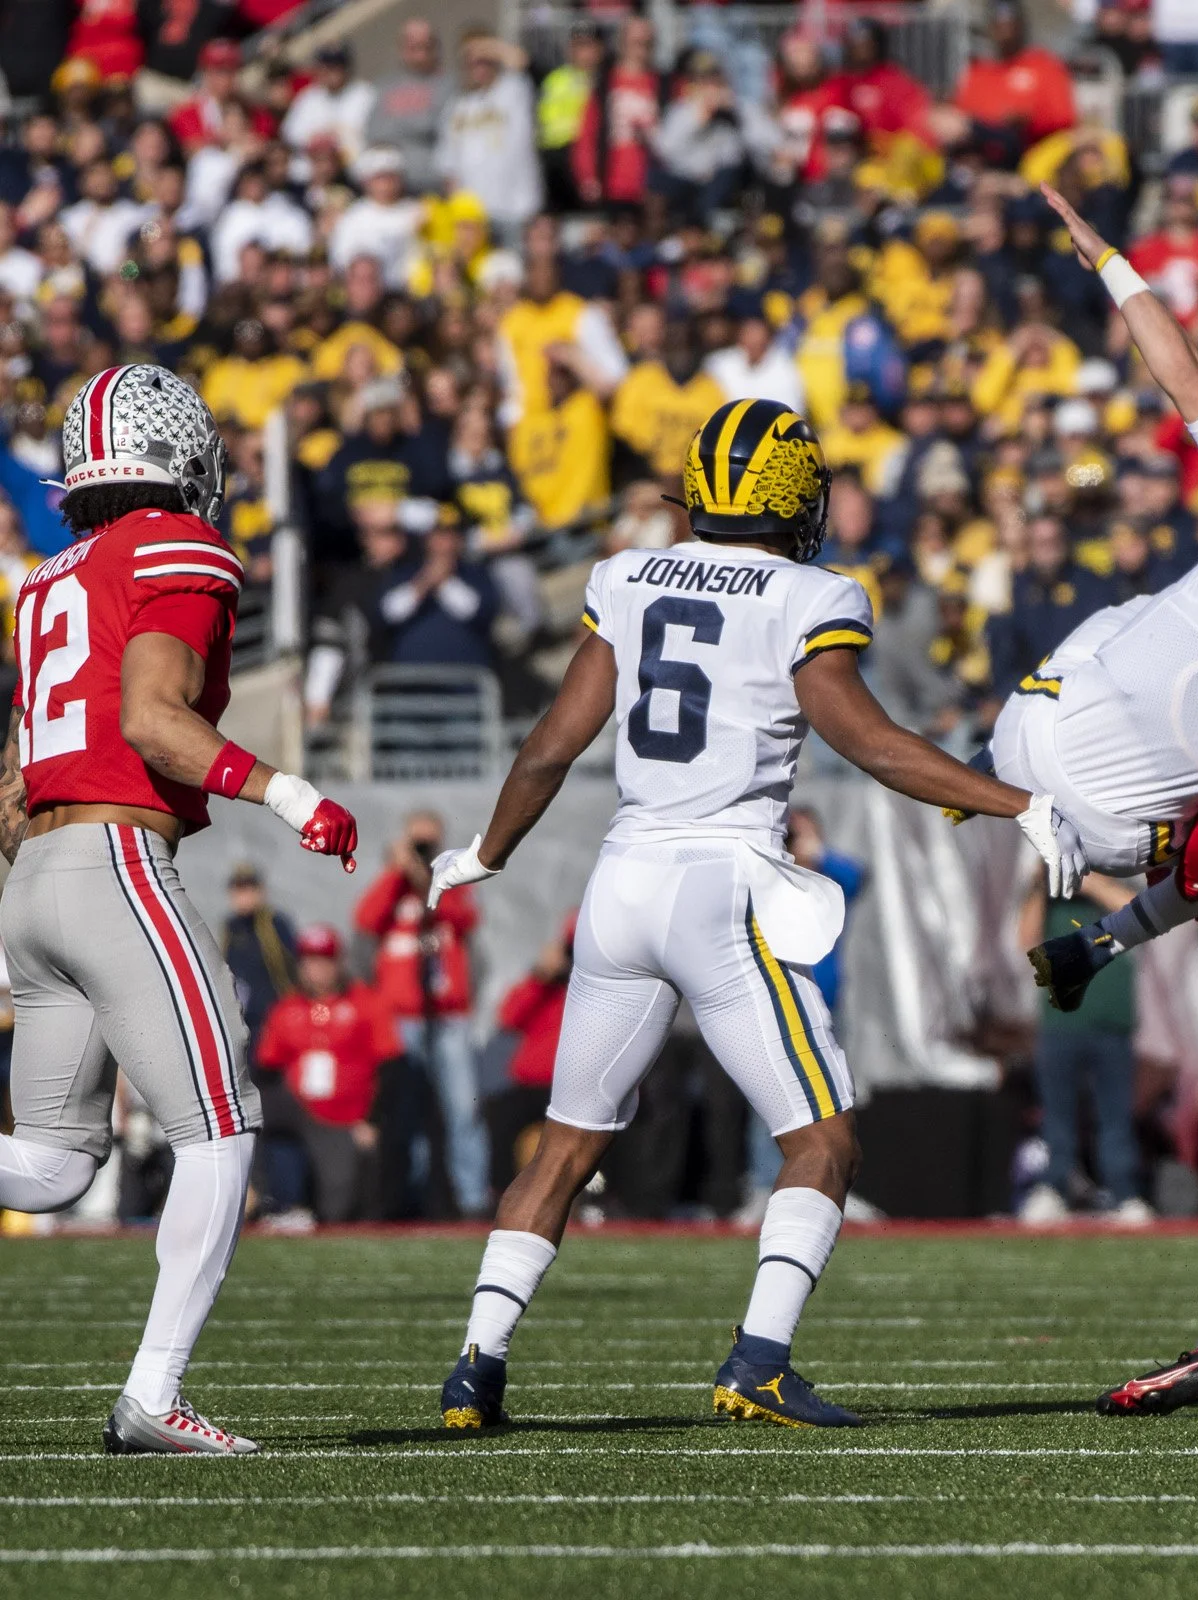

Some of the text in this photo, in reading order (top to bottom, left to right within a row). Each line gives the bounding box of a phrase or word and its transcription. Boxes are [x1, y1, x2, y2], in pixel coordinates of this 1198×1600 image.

[116, 437, 127, 447] 12
[66, 467, 145, 487] BUCKEYES
[627, 557, 776, 597] JOHNSON
[18, 572, 91, 770] 12
[628, 595, 725, 764] 6
